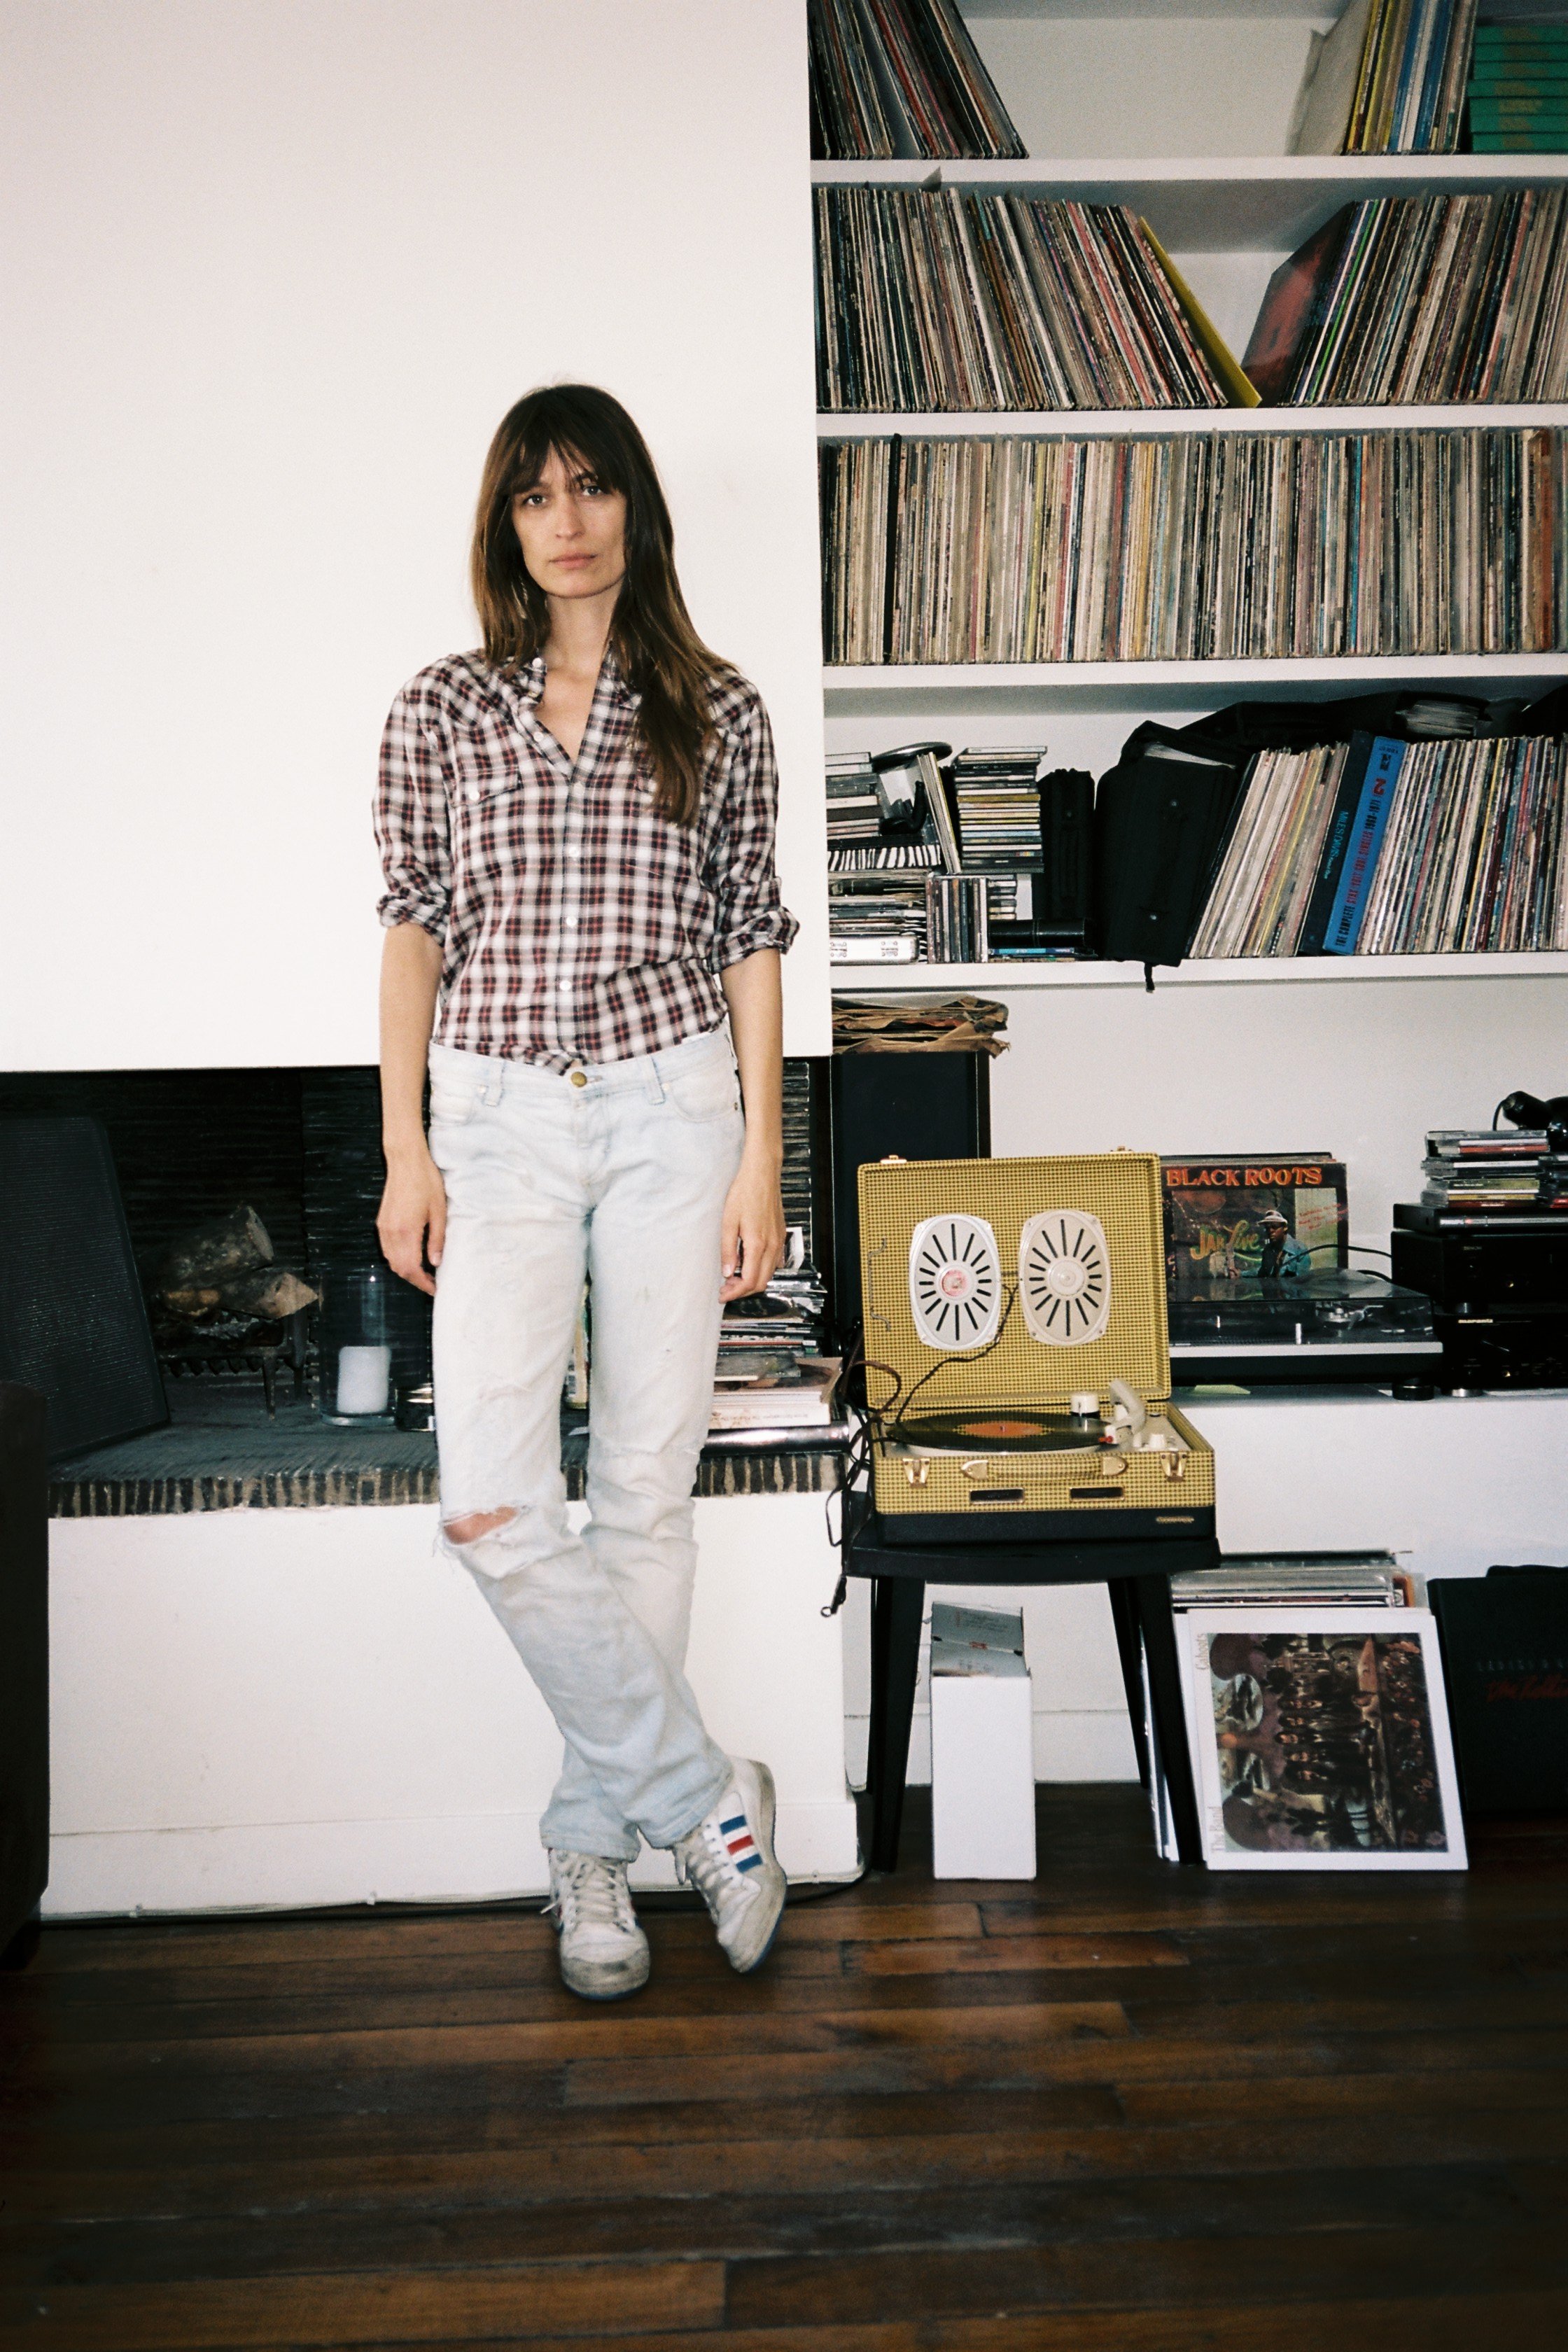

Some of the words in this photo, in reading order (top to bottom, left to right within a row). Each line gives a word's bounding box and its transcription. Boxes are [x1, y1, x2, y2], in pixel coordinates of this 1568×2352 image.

[1373, 778, 1386, 795] 2
[1335, 810, 1349, 834] MILES
[1331, 835, 1343, 858] DAVIS
[1358, 831, 1374, 855] SINGLES
[1346, 889, 1359, 904] STAX
[1338, 905, 1355, 935] COMPLETE
[1336, 936, 1348, 947] THE
[1166, 1168, 1240, 1186] BLACK
[1245, 1167, 1323, 1186] ROOTS
[1195, 1633, 1209, 1670] Cahoots
[1207, 1806, 1224, 1831] Band
